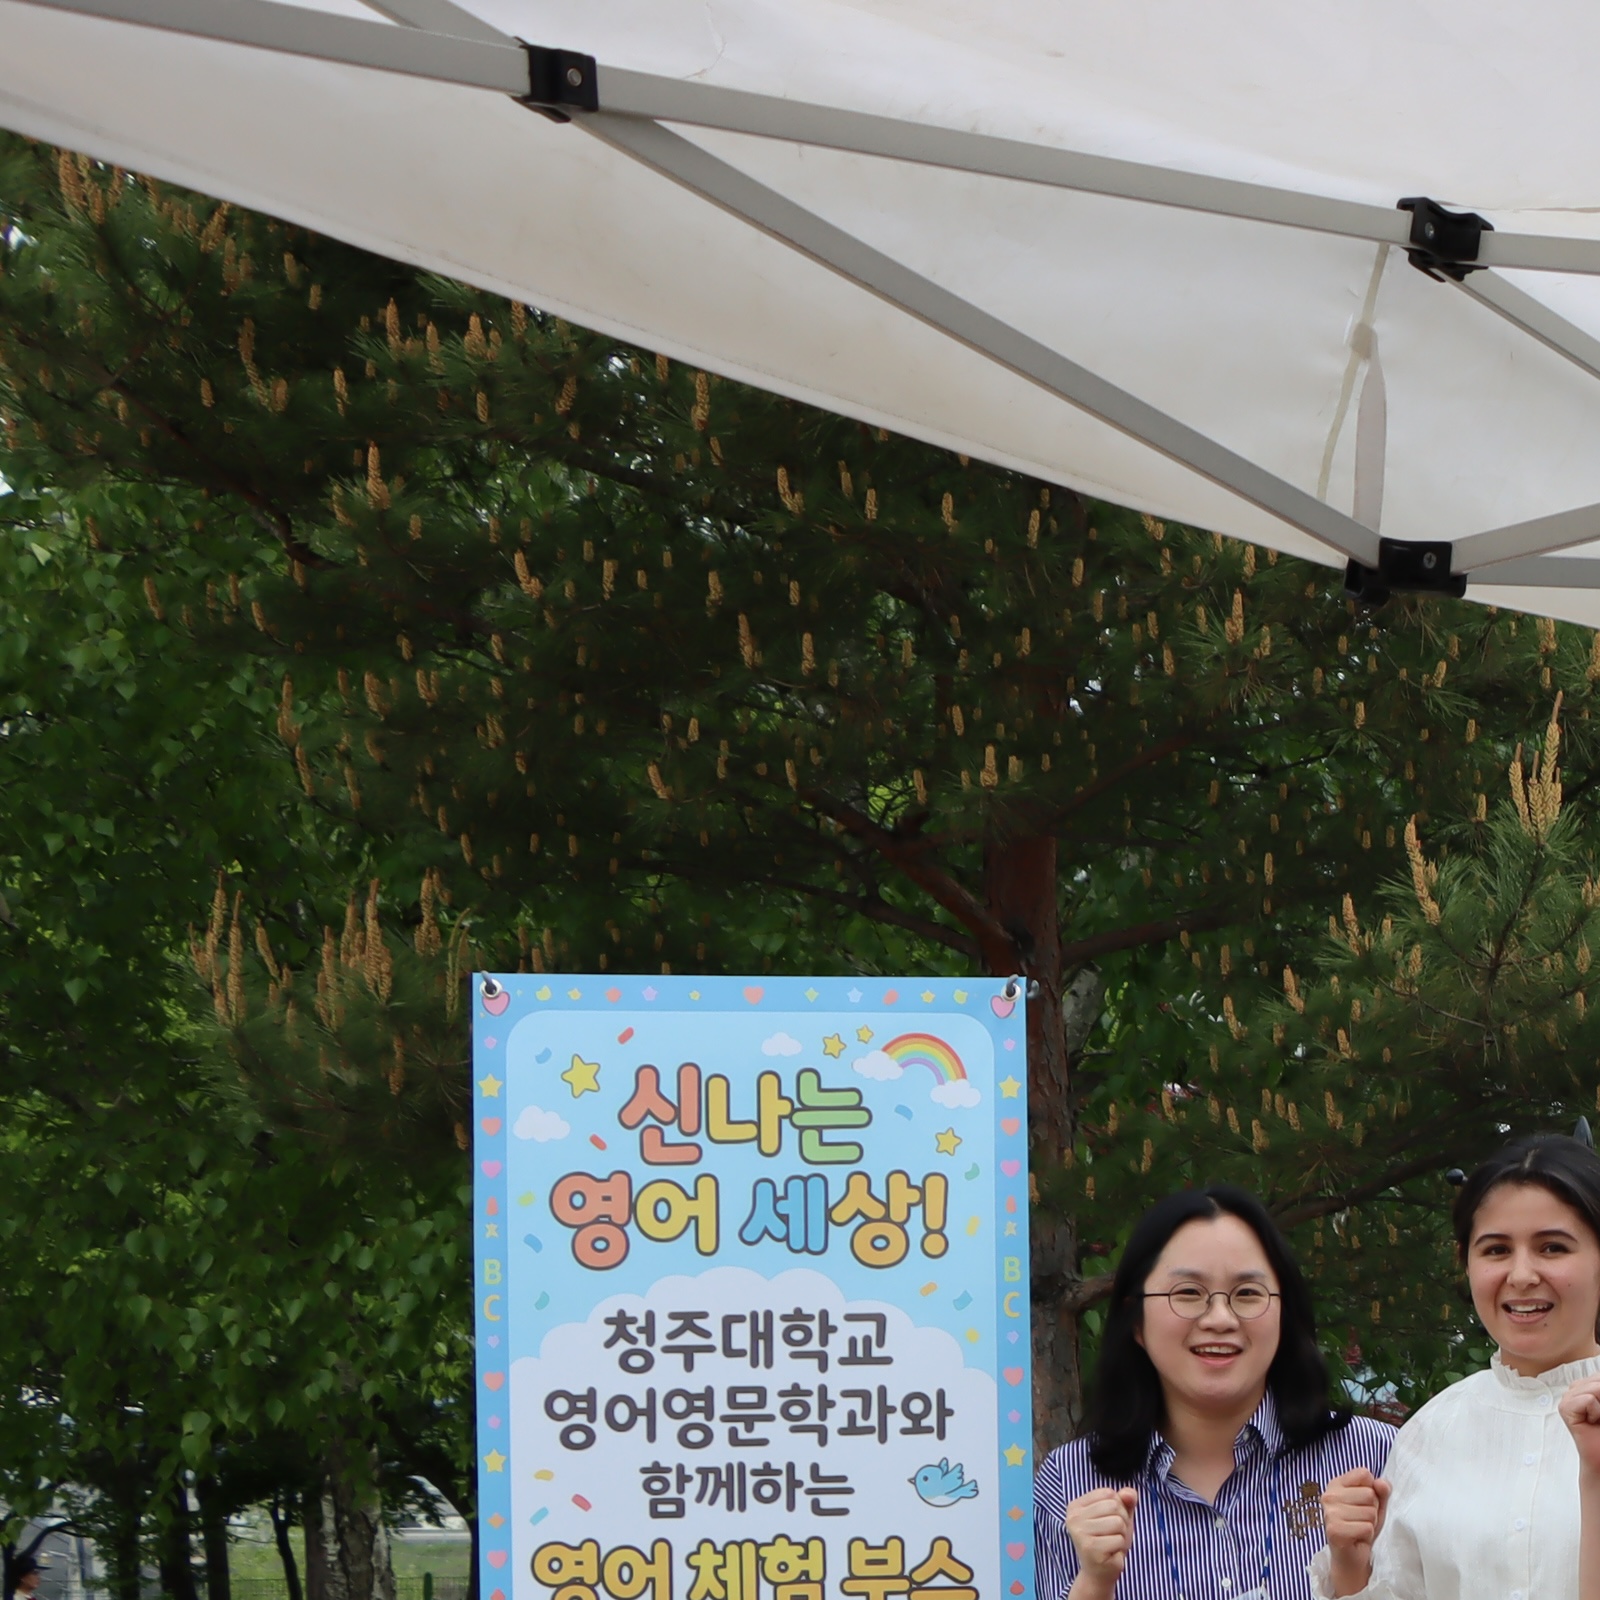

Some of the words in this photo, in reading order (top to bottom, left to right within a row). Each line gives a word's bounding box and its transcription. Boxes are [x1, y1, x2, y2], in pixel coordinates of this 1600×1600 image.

[618, 1062, 872, 1165] 신나는
[549, 1170, 720, 1270] 영어
[739, 1170, 949, 1268] 세상!
[603, 1307, 894, 1374] 청주대학교
[544, 1384, 954, 1450] 영어영문학과와
[640, 1461, 855, 1518] 함께하는
